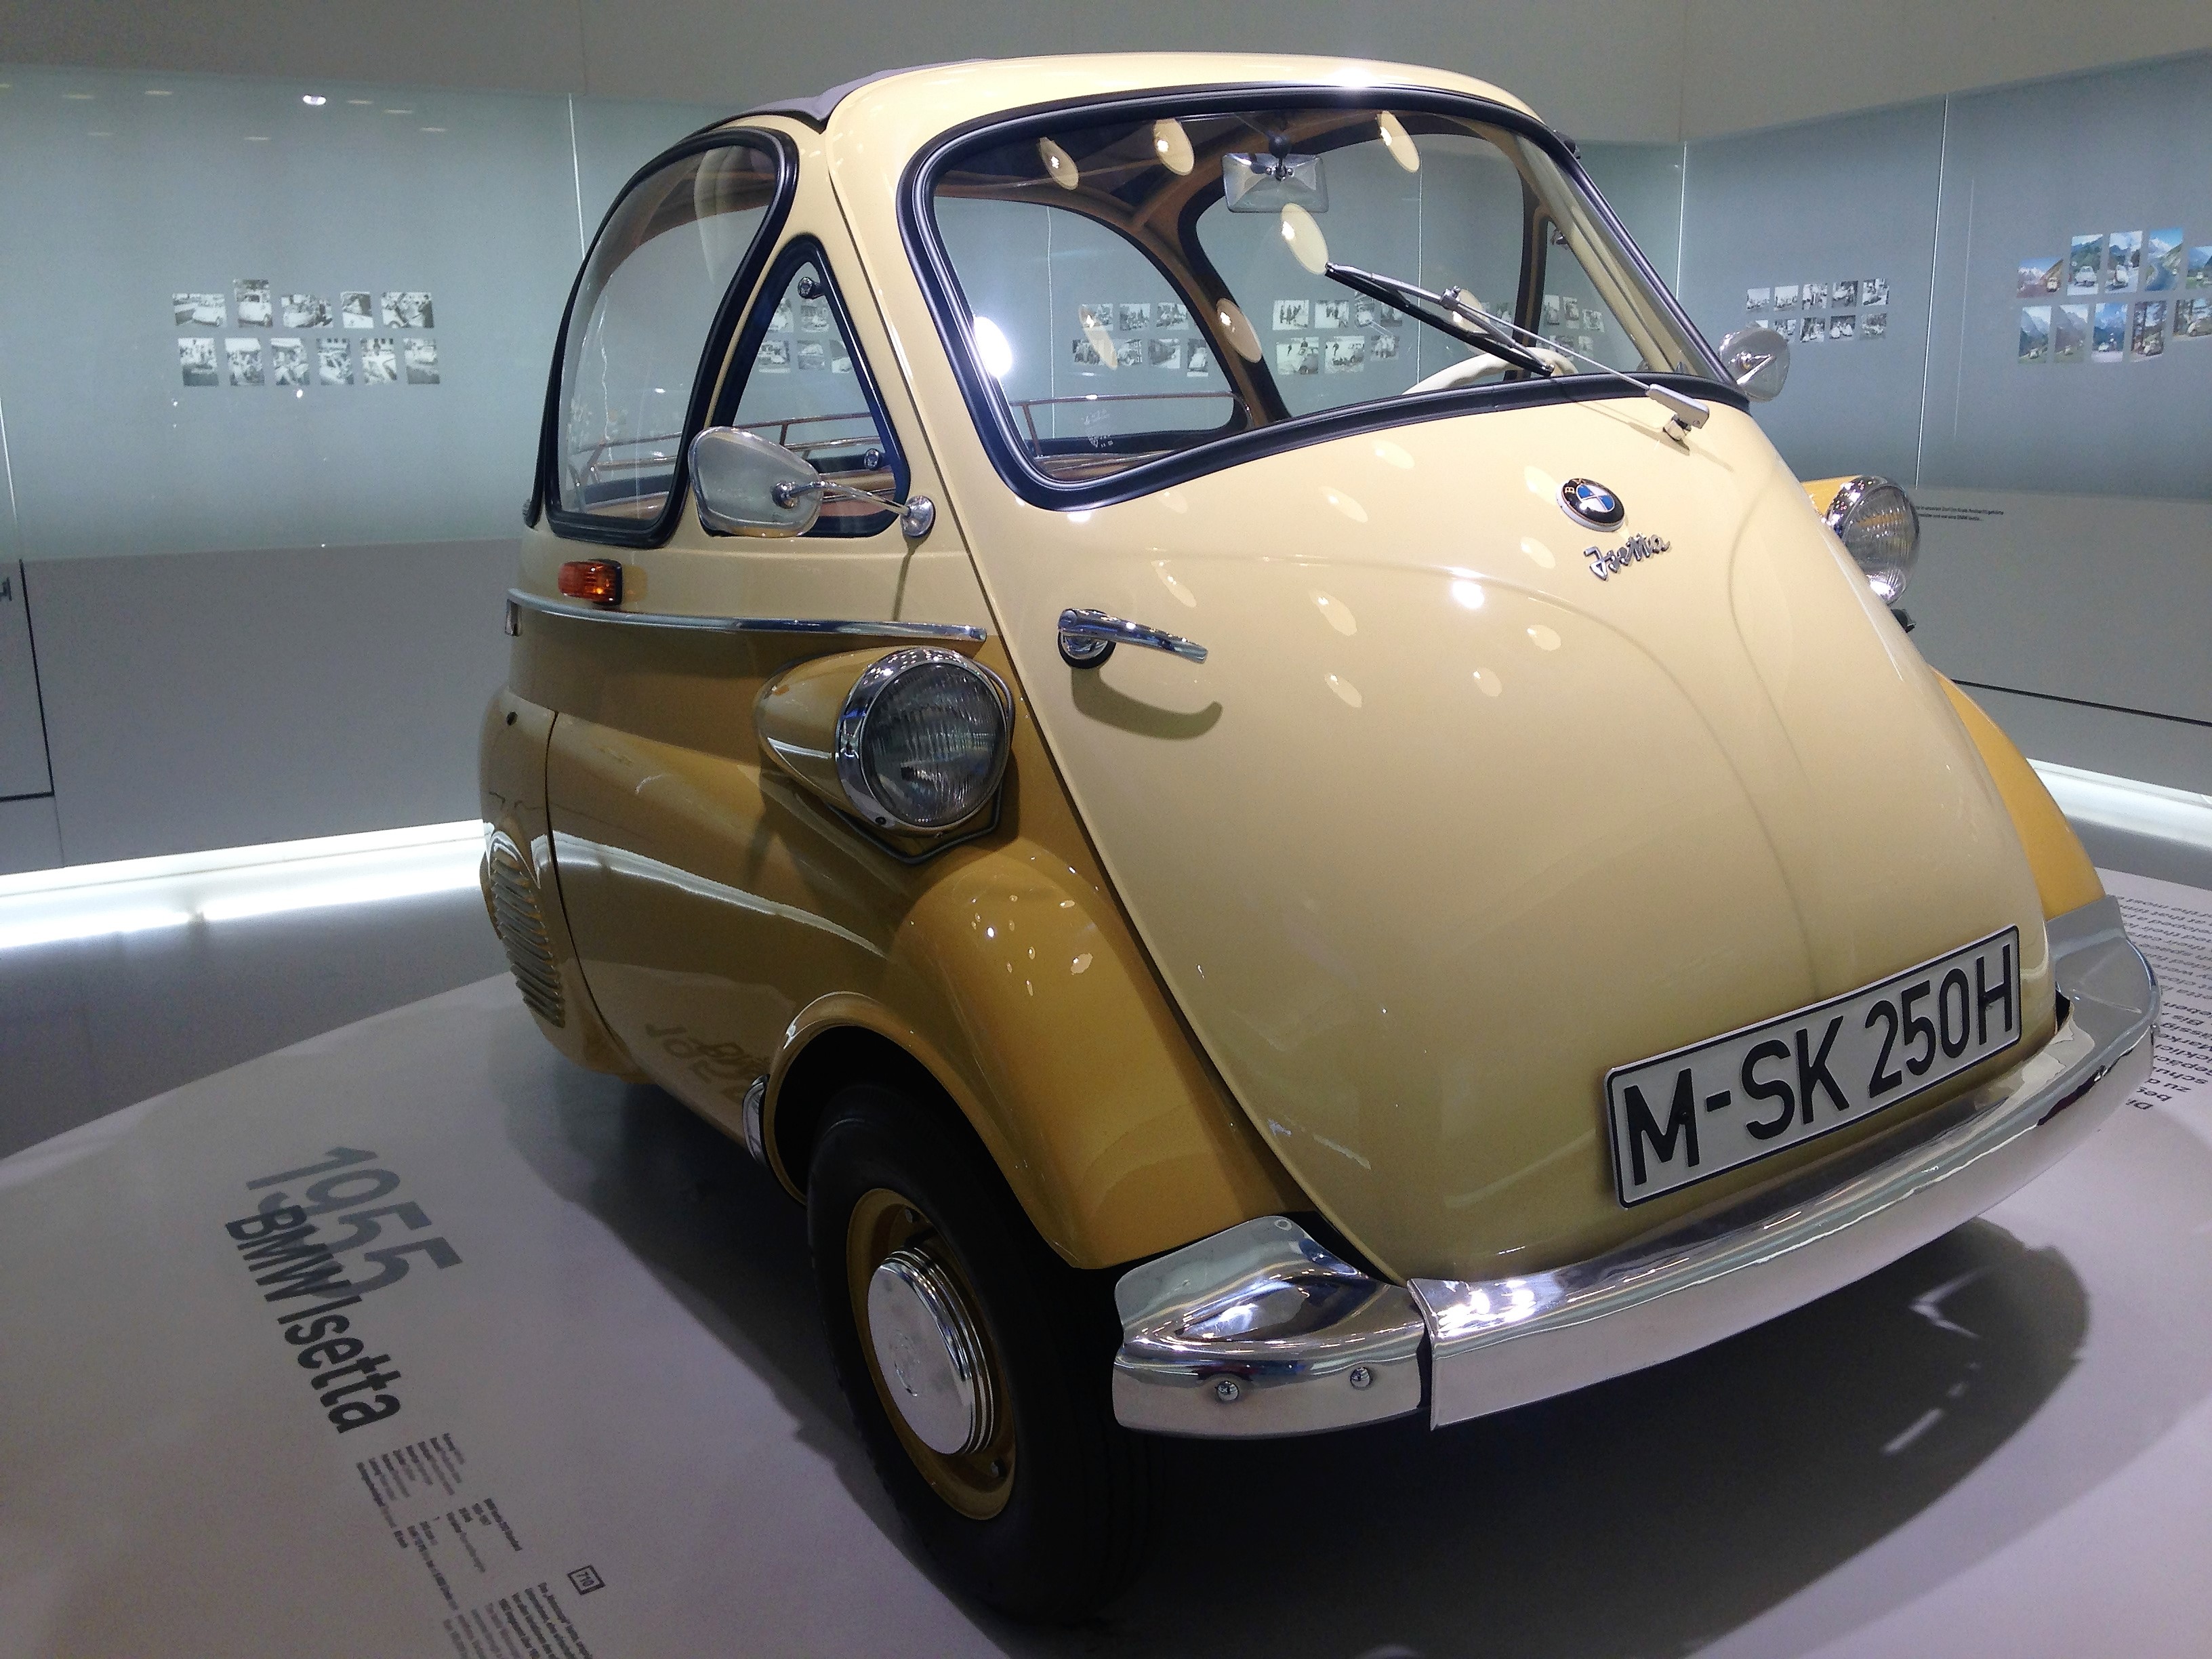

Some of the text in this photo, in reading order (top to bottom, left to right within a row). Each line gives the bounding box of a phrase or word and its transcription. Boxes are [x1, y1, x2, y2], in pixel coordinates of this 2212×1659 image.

[1624, 944, 2013, 1185] M-SK 250H
[2125, 1099, 2154, 1110] Di
[2153, 1067, 2209, 1084] schu
[246, 1146, 463, 1299] 1955
[225, 1204, 402, 1434] BMW Isetta
